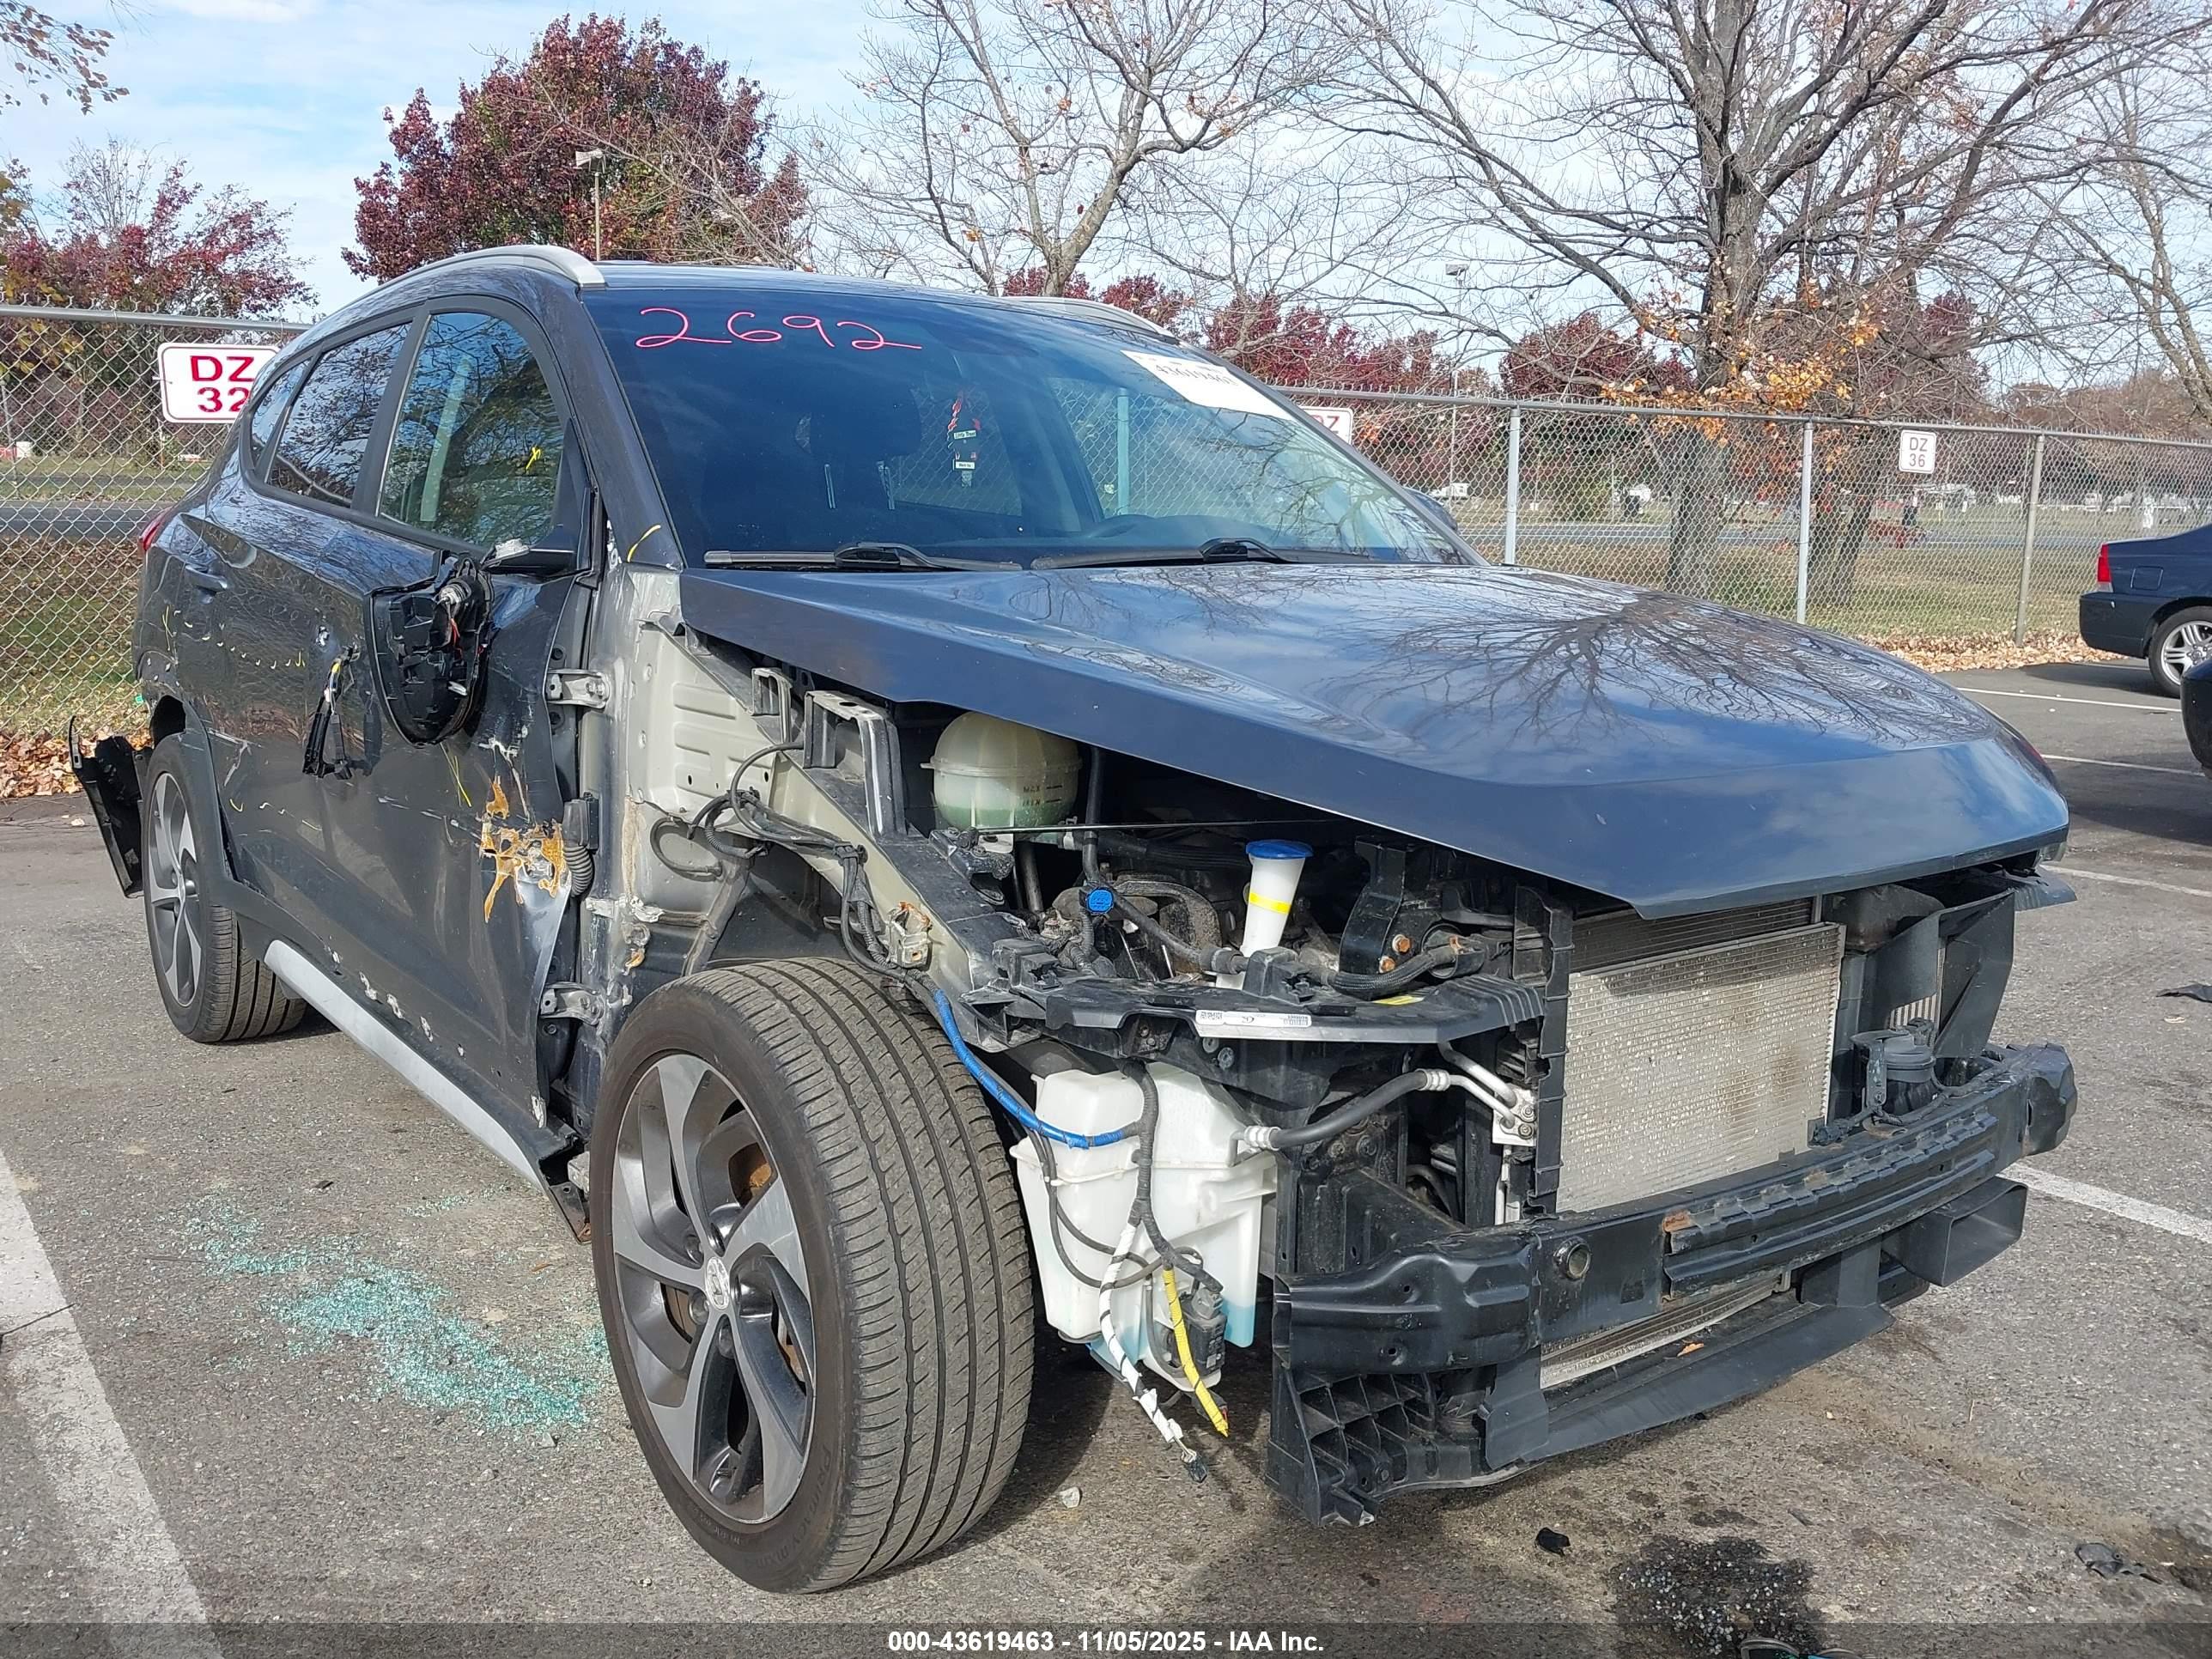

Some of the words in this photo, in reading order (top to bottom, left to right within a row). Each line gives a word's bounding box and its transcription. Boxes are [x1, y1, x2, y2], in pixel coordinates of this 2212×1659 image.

[635, 307, 922, 350] 2692
[190, 355, 255, 383] DZ
[197, 386, 249, 413] 32
[1910, 437, 1928, 452] DZ
[1909, 453, 1925, 467] 36
